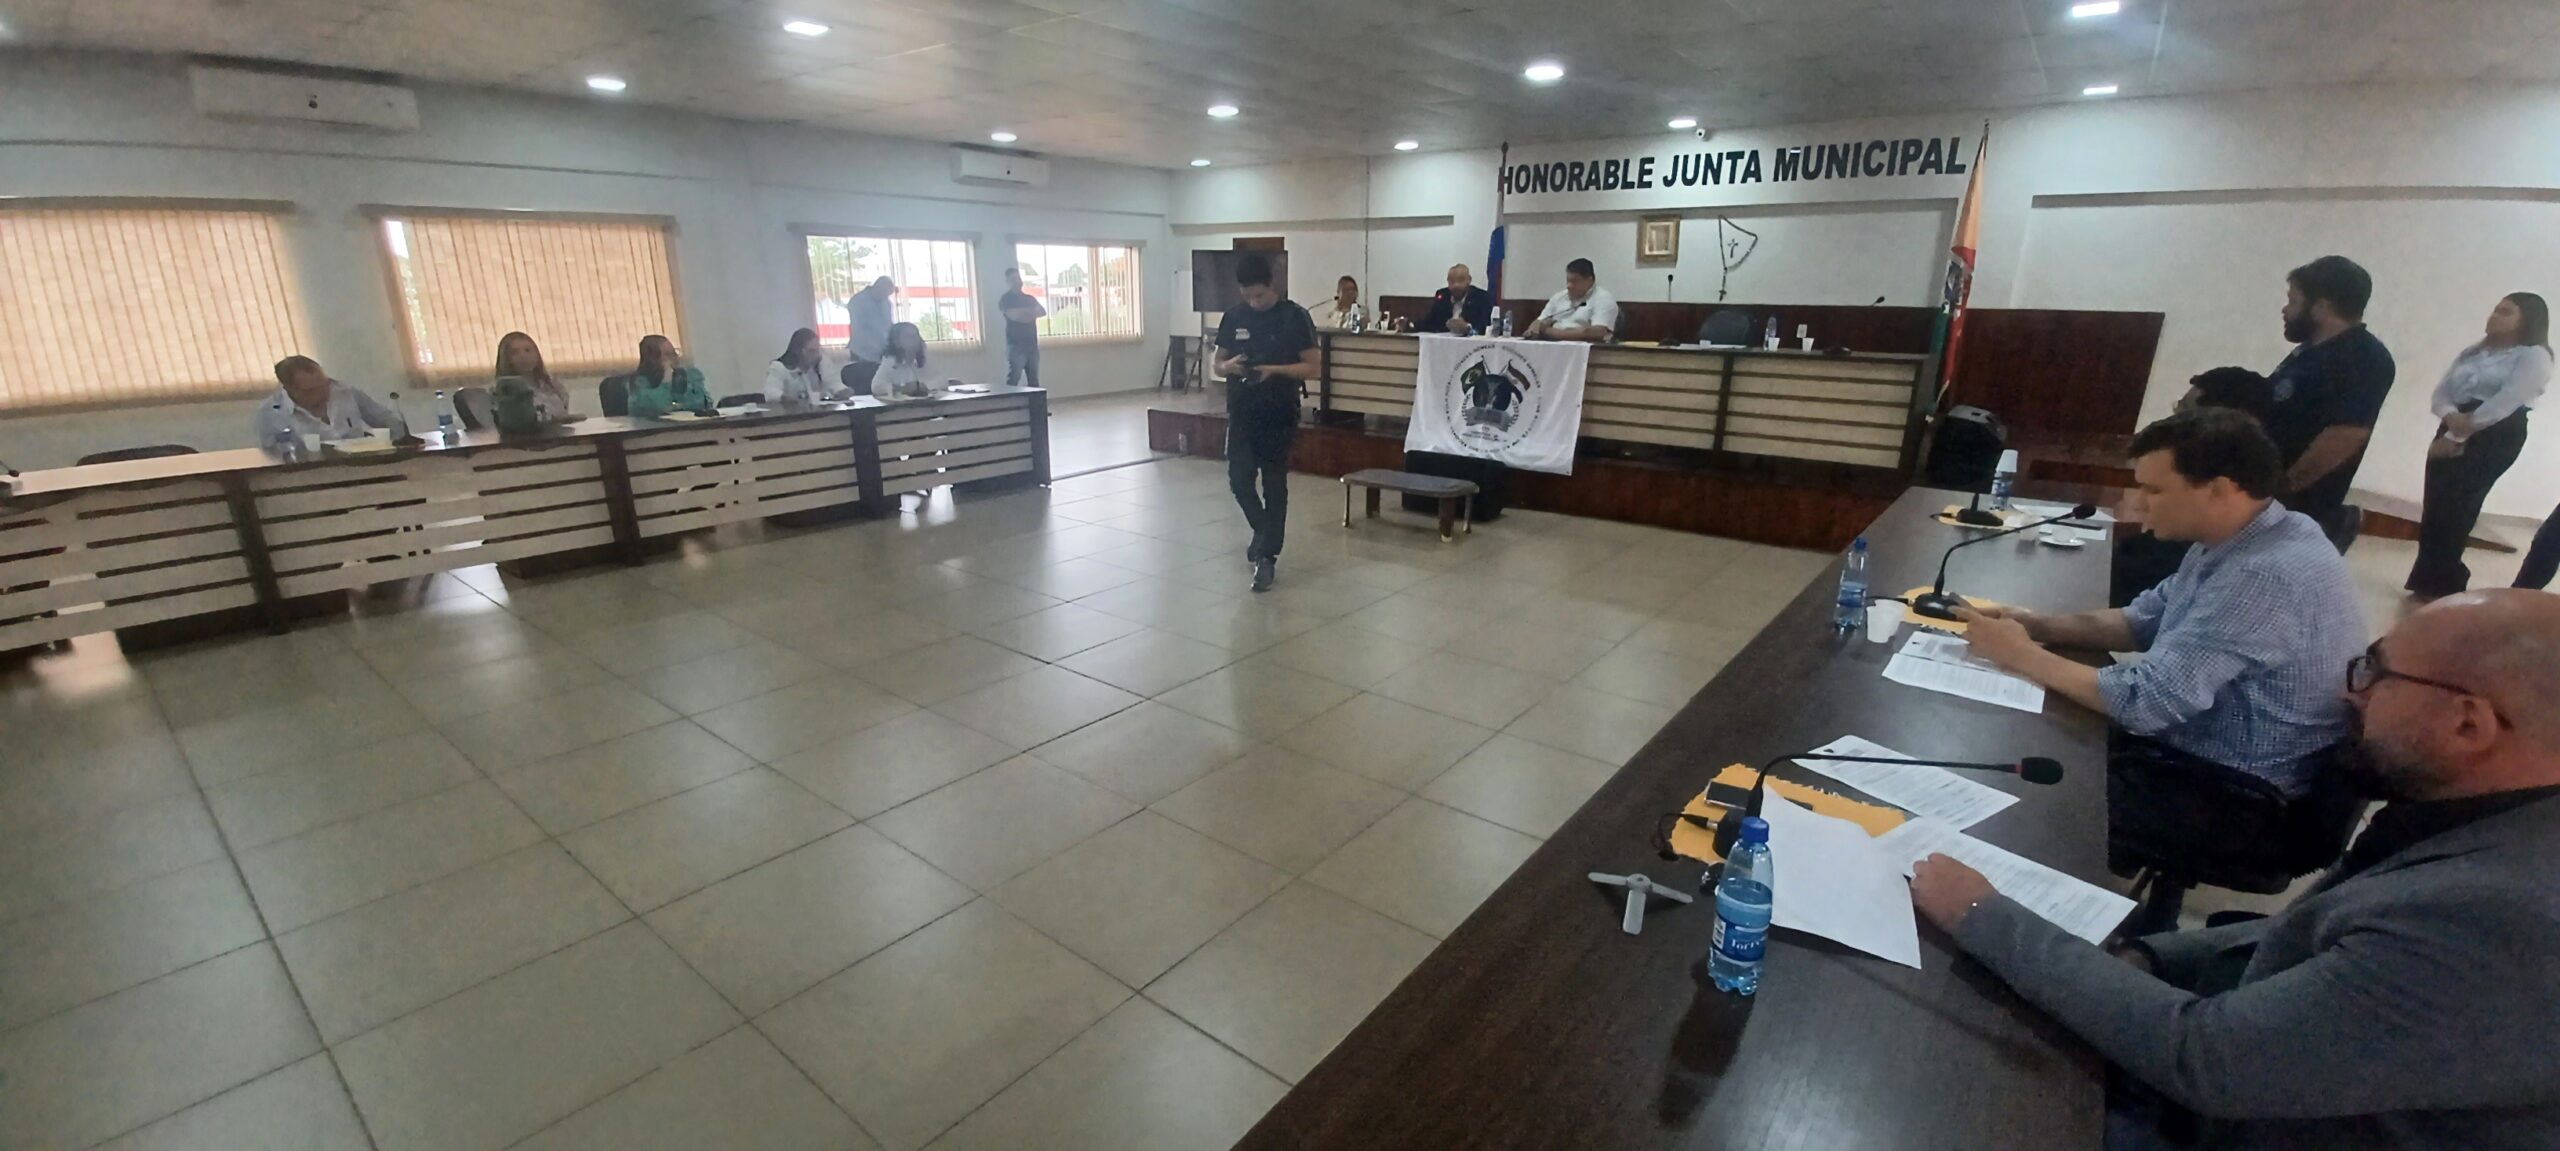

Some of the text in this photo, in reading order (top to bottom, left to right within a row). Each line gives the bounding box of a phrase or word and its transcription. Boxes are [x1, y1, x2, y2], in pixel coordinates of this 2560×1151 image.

[1497, 137, 1967, 195] HONORABLE JUNTA MUNICIPAL
